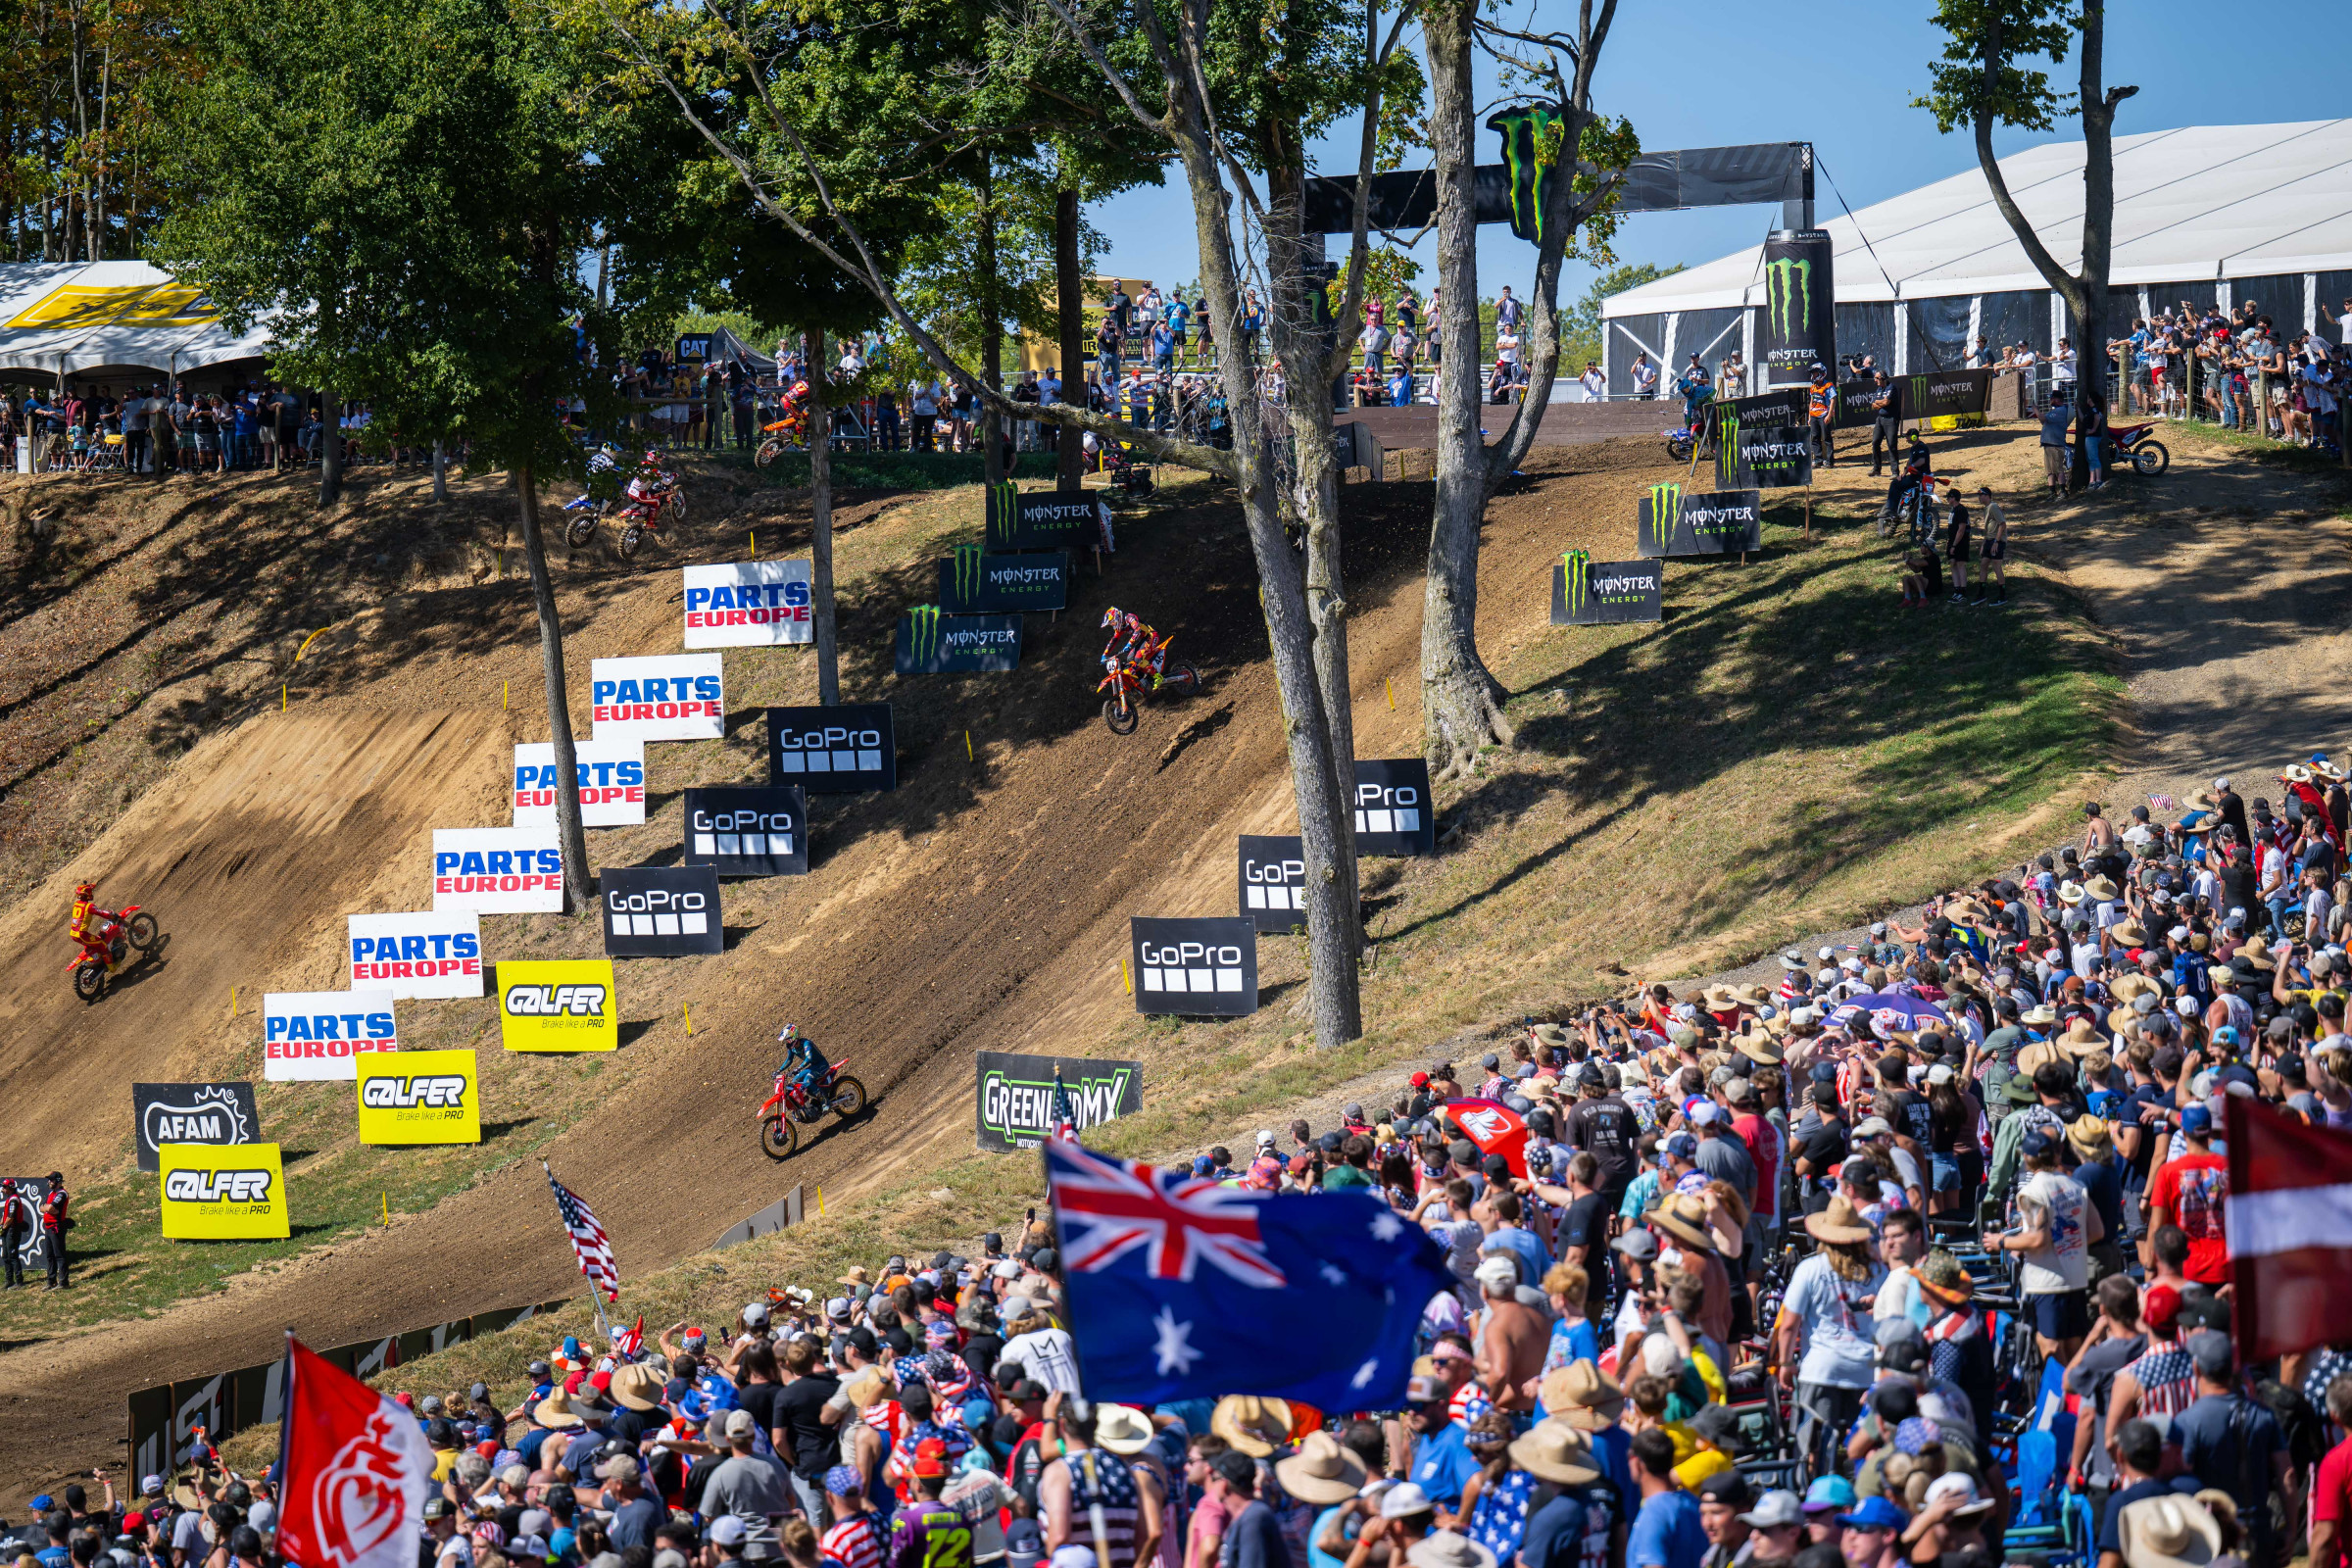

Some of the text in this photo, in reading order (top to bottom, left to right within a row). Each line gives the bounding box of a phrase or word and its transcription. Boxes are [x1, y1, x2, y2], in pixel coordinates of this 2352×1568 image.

[680, 340, 709, 358] CAT
[1846, 392, 1876, 407] MONS
[1741, 404, 1790, 422] MONSTER
[1741, 442, 1806, 462] MONSTER
[1750, 461, 1796, 470] ENERGY
[1024, 504, 1093, 522] MONSTER
[1685, 506, 1754, 526] MONSTER
[1033, 521, 1082, 531] ENERGY
[1694, 525, 1744, 535] ENERGY
[990, 566, 1060, 585] MONSTER
[1592, 574, 1656, 595] MONSTER
[686, 581, 809, 612] PARTS
[1001, 585, 1050, 594] ENERGY
[1601, 595, 1646, 605] ENERGY
[687, 606, 810, 628] EUROPE
[946, 628, 1016, 647] MONSTER
[955, 647, 1004, 656] ENERGY
[593, 675, 721, 705] PARTS
[593, 701, 722, 722] EUROPE
[781, 726, 880, 750] GoPro
[515, 786, 644, 808] EUOPE
[1354, 783, 1418, 807] Pro
[694, 809, 792, 832] GoPro
[436, 849, 563, 875] PARTS
[1246, 858, 1305, 883] GoP
[436, 874, 563, 894] EUROPE
[609, 890, 706, 912] GoPro
[352, 932, 479, 962] PARTS
[1141, 941, 1242, 966] GoPro
[353, 958, 480, 980] EUROPE
[2196, 966, 2207, 993] 8
[507, 985, 606, 1015] GALFER
[266, 1011, 396, 1042] PARTS
[542, 1019, 564, 1029] Brake
[564, 1019, 578, 1029] like
[586, 1019, 605, 1028] PRO
[267, 1038, 397, 1059] EUROPE
[363, 1075, 466, 1107] GALFER
[396, 1109, 465, 1121] Brake like a PRO
[158, 1115, 221, 1139] AFAM
[166, 1169, 270, 1201] GALFER
[199, 1204, 271, 1215] Brake like a PRO
[924, 1527, 971, 1568] 72
